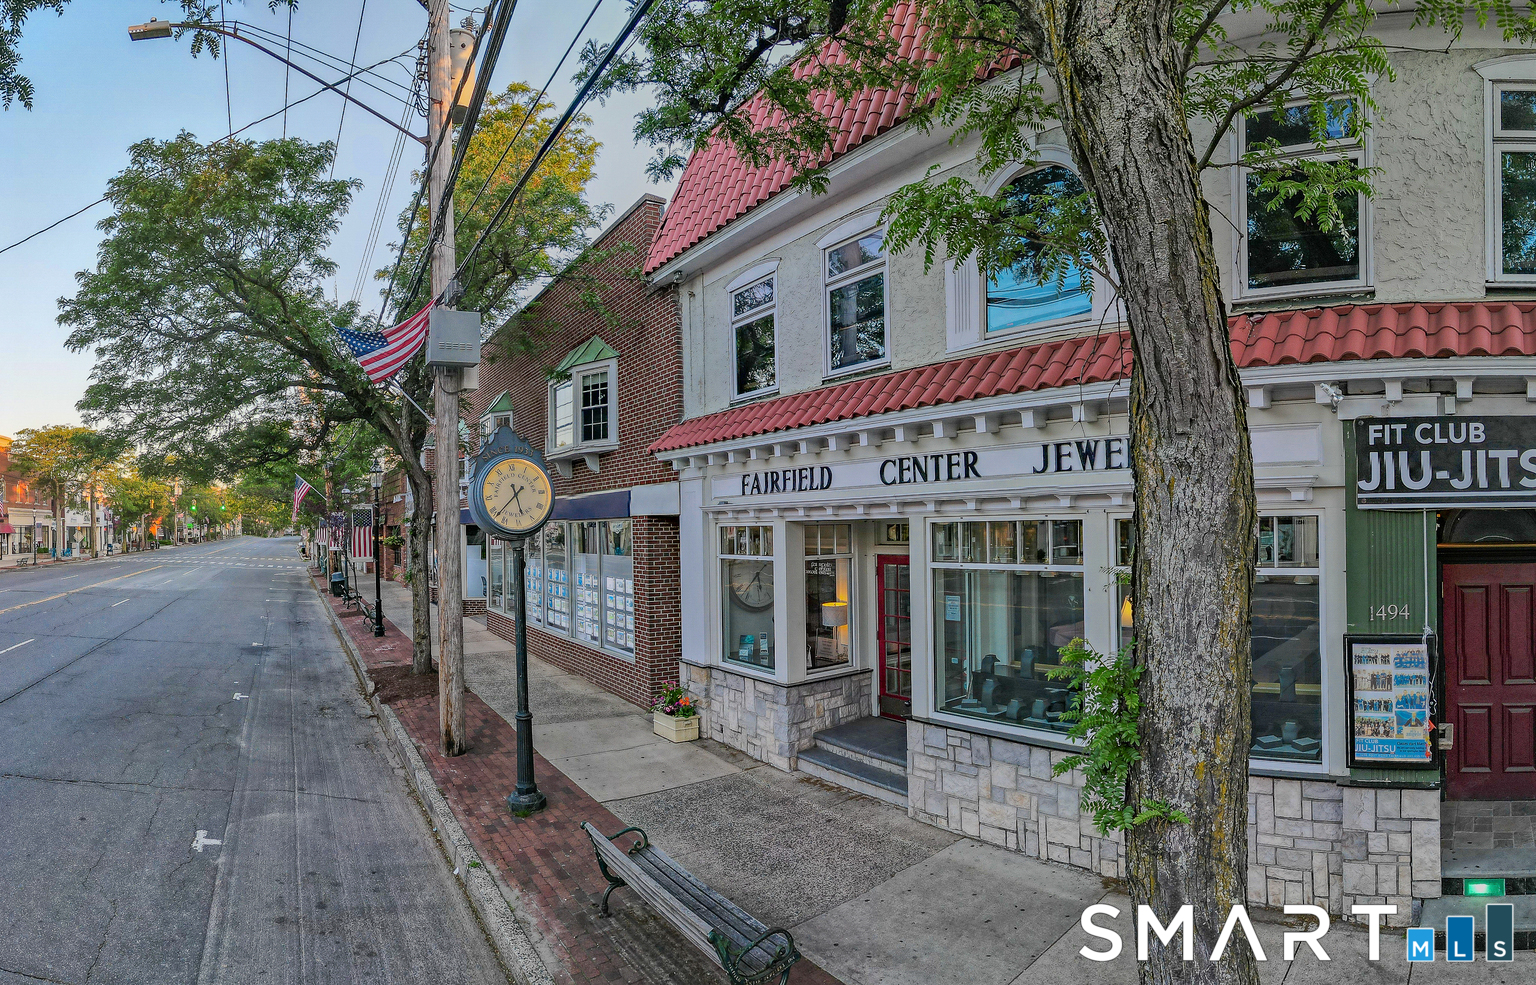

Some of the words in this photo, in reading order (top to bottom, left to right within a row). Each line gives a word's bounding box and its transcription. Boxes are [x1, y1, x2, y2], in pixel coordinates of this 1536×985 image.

[1368, 423, 1407, 445] FIT
[1414, 422, 1486, 444] CLUB
[482, 445, 510, 462] SINCE
[514, 446, 534, 457] 1933
[742, 466, 832, 495] FAIRFIELD
[880, 451, 981, 486] CENTER
[494, 472, 516, 498] FAIRFIELD
[517, 473, 536, 493] CENTER
[1369, 604, 1410, 621] 1494
[1355, 744, 1396, 752] JIU-JITSU
